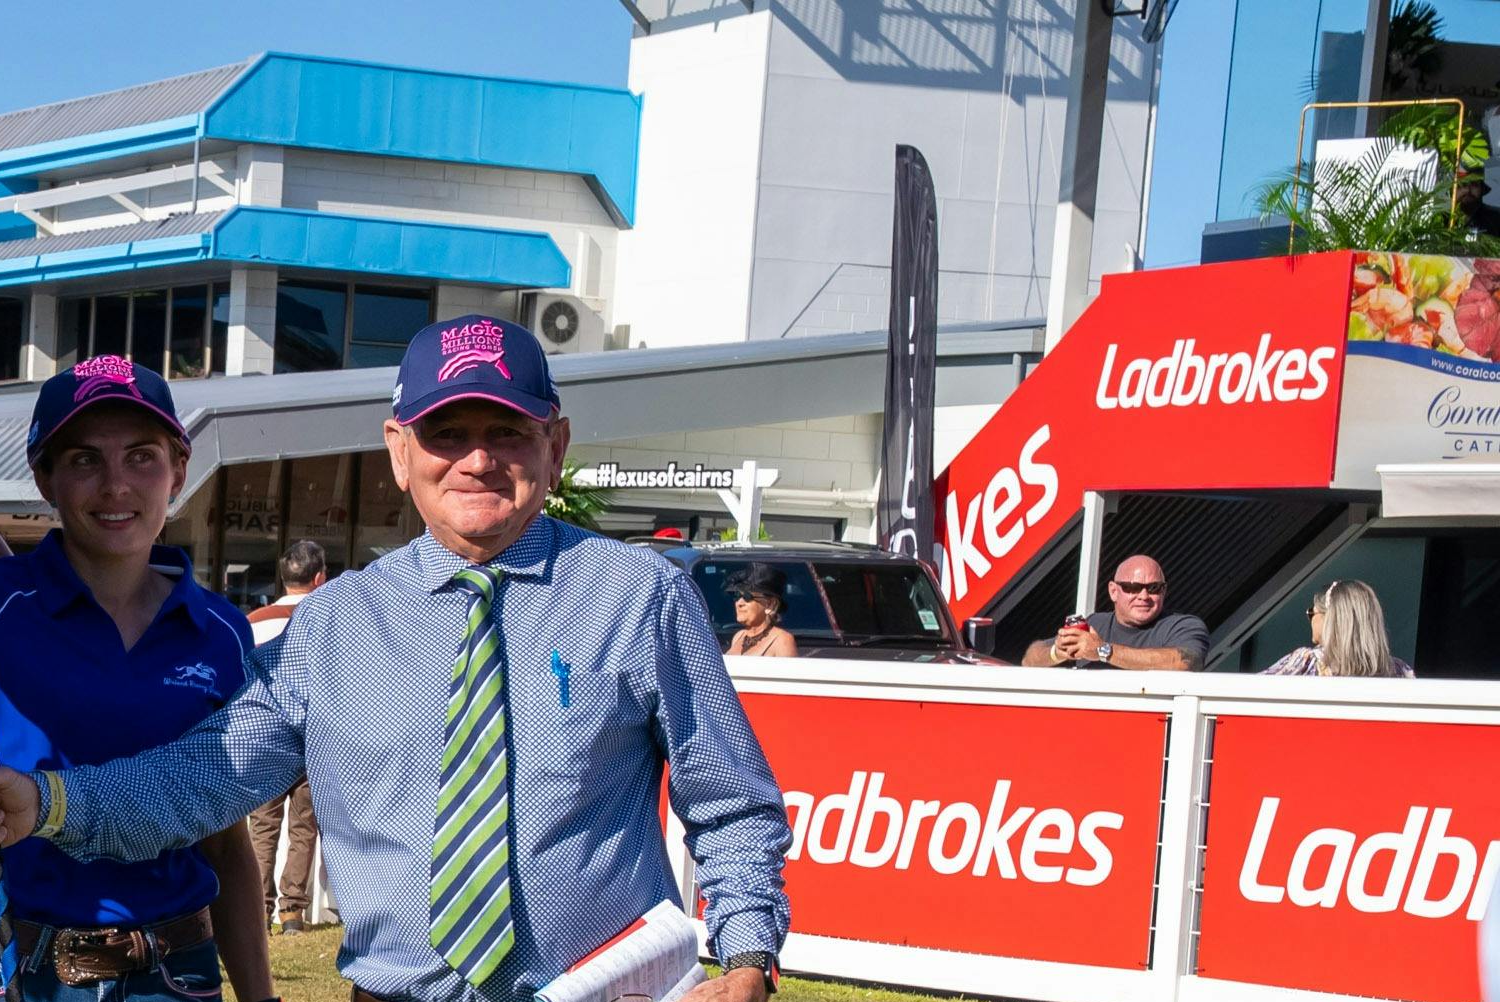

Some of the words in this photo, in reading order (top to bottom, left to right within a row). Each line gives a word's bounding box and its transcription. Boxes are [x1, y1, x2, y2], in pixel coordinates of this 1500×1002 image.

[441, 324, 503, 342] MAGIC
[441, 335, 501, 351] MILLIONS
[1096, 333, 1336, 409] Ladbrokes
[1454, 439, 1500, 452] CAT
[597, 461, 733, 488] #lexusofcairns
[782, 771, 1124, 886] adbrokes
